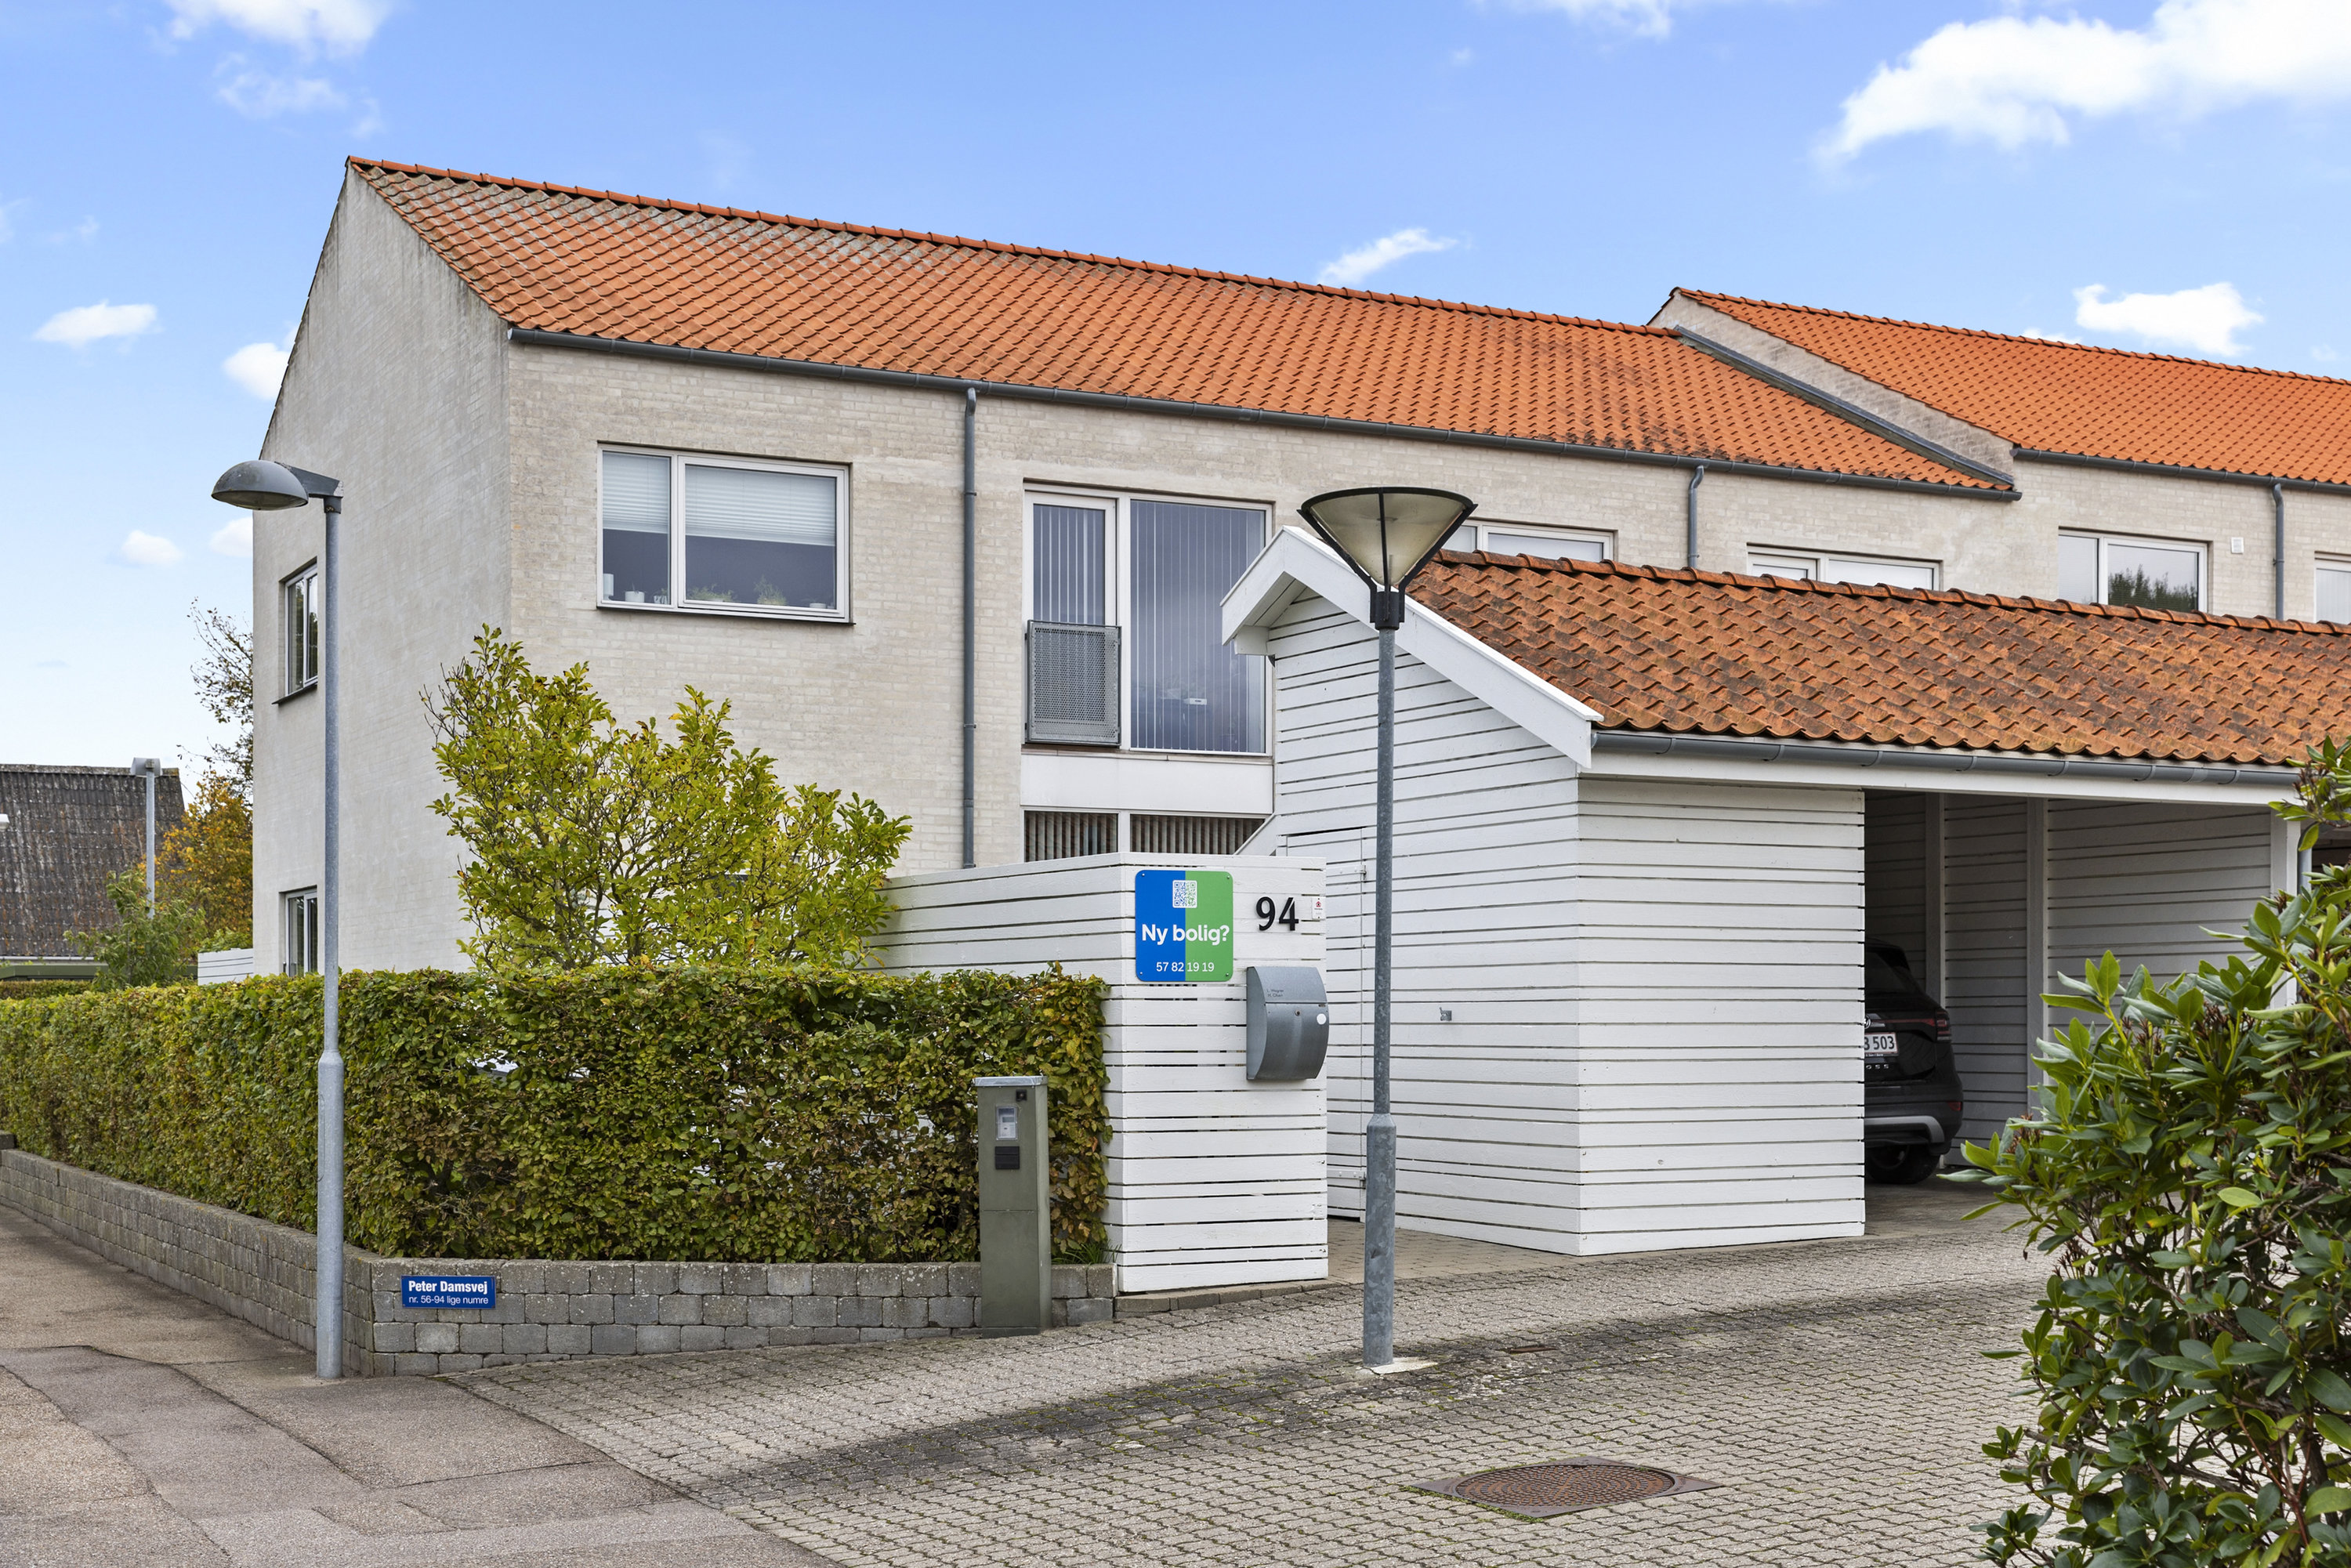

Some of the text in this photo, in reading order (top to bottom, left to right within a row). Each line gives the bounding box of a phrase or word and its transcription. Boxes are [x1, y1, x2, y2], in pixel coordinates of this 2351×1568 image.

[1256, 896, 1299, 931] 94
[1142, 924, 1230, 946] Ny bolig?
[1156, 961, 1215, 972] 57 82 19 19
[1873, 1035, 1895, 1050] 503
[408, 1280, 488, 1295] Peter Damsvej
[420, 1295, 444, 1304] 56-94
[447, 1296, 461, 1305] lige
